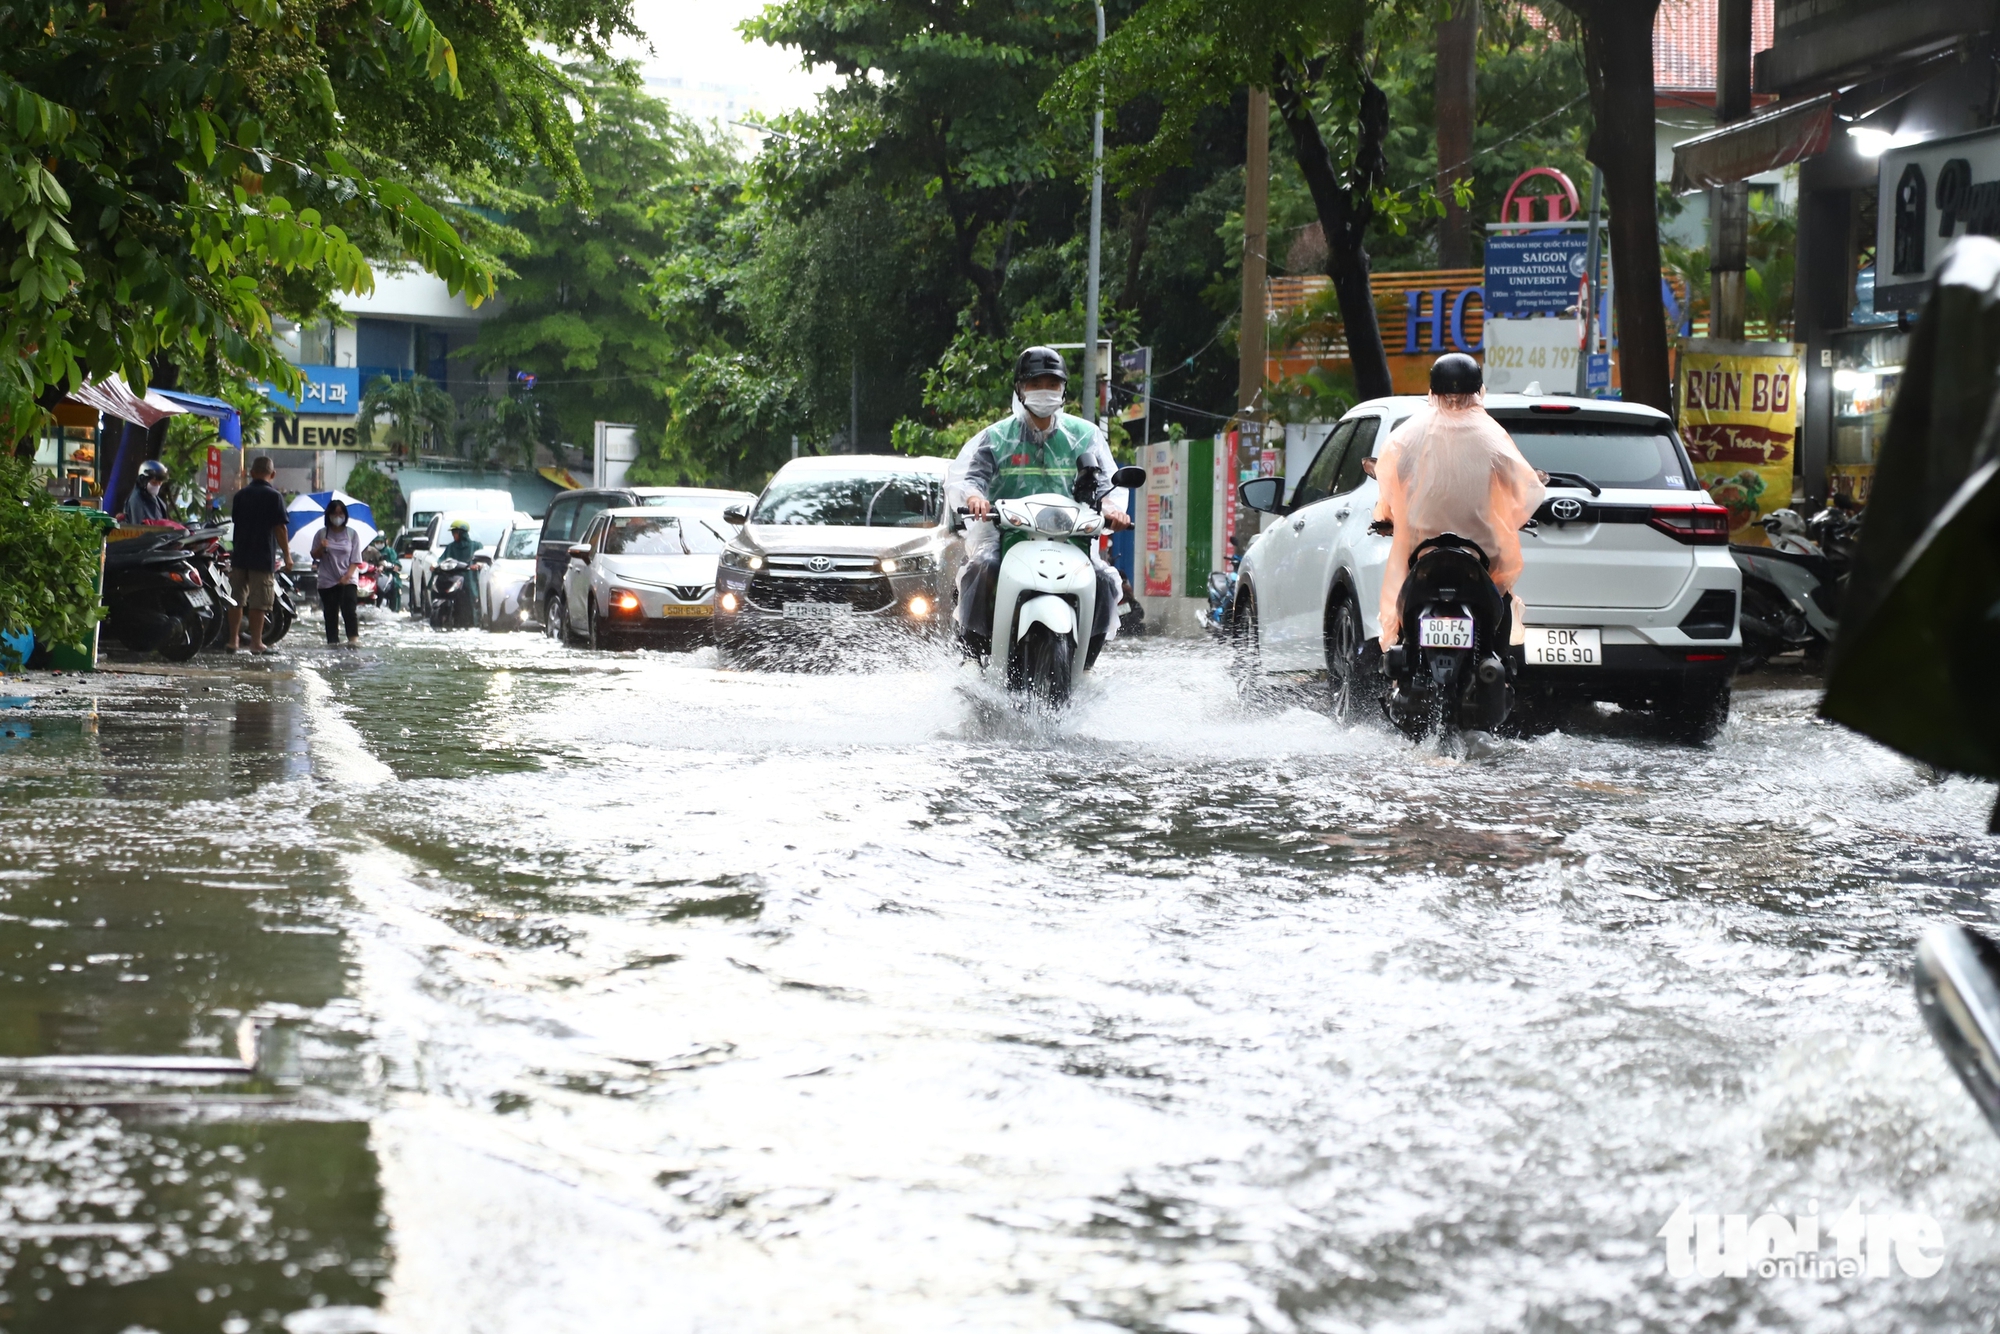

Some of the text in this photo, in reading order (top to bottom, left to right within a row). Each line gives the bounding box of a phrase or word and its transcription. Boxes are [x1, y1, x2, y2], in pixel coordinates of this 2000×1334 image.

[1522, 252, 1568, 263] SAIGON
[1489, 265, 1568, 275] INTERNATIONAL
[1509, 276, 1568, 285] UNIVERSITY
[1543, 290, 1568, 298] Campus
[1488, 345, 1524, 368] 0922
[1528, 346, 1546, 368] 48
[1686, 362, 1790, 413] BÚN BÒ
[1429, 620, 1465, 632] 60-F4
[1425, 633, 1470, 646] 100.67
[1547, 630, 1578, 645] 60K
[1537, 648, 1593, 663] 166.90
